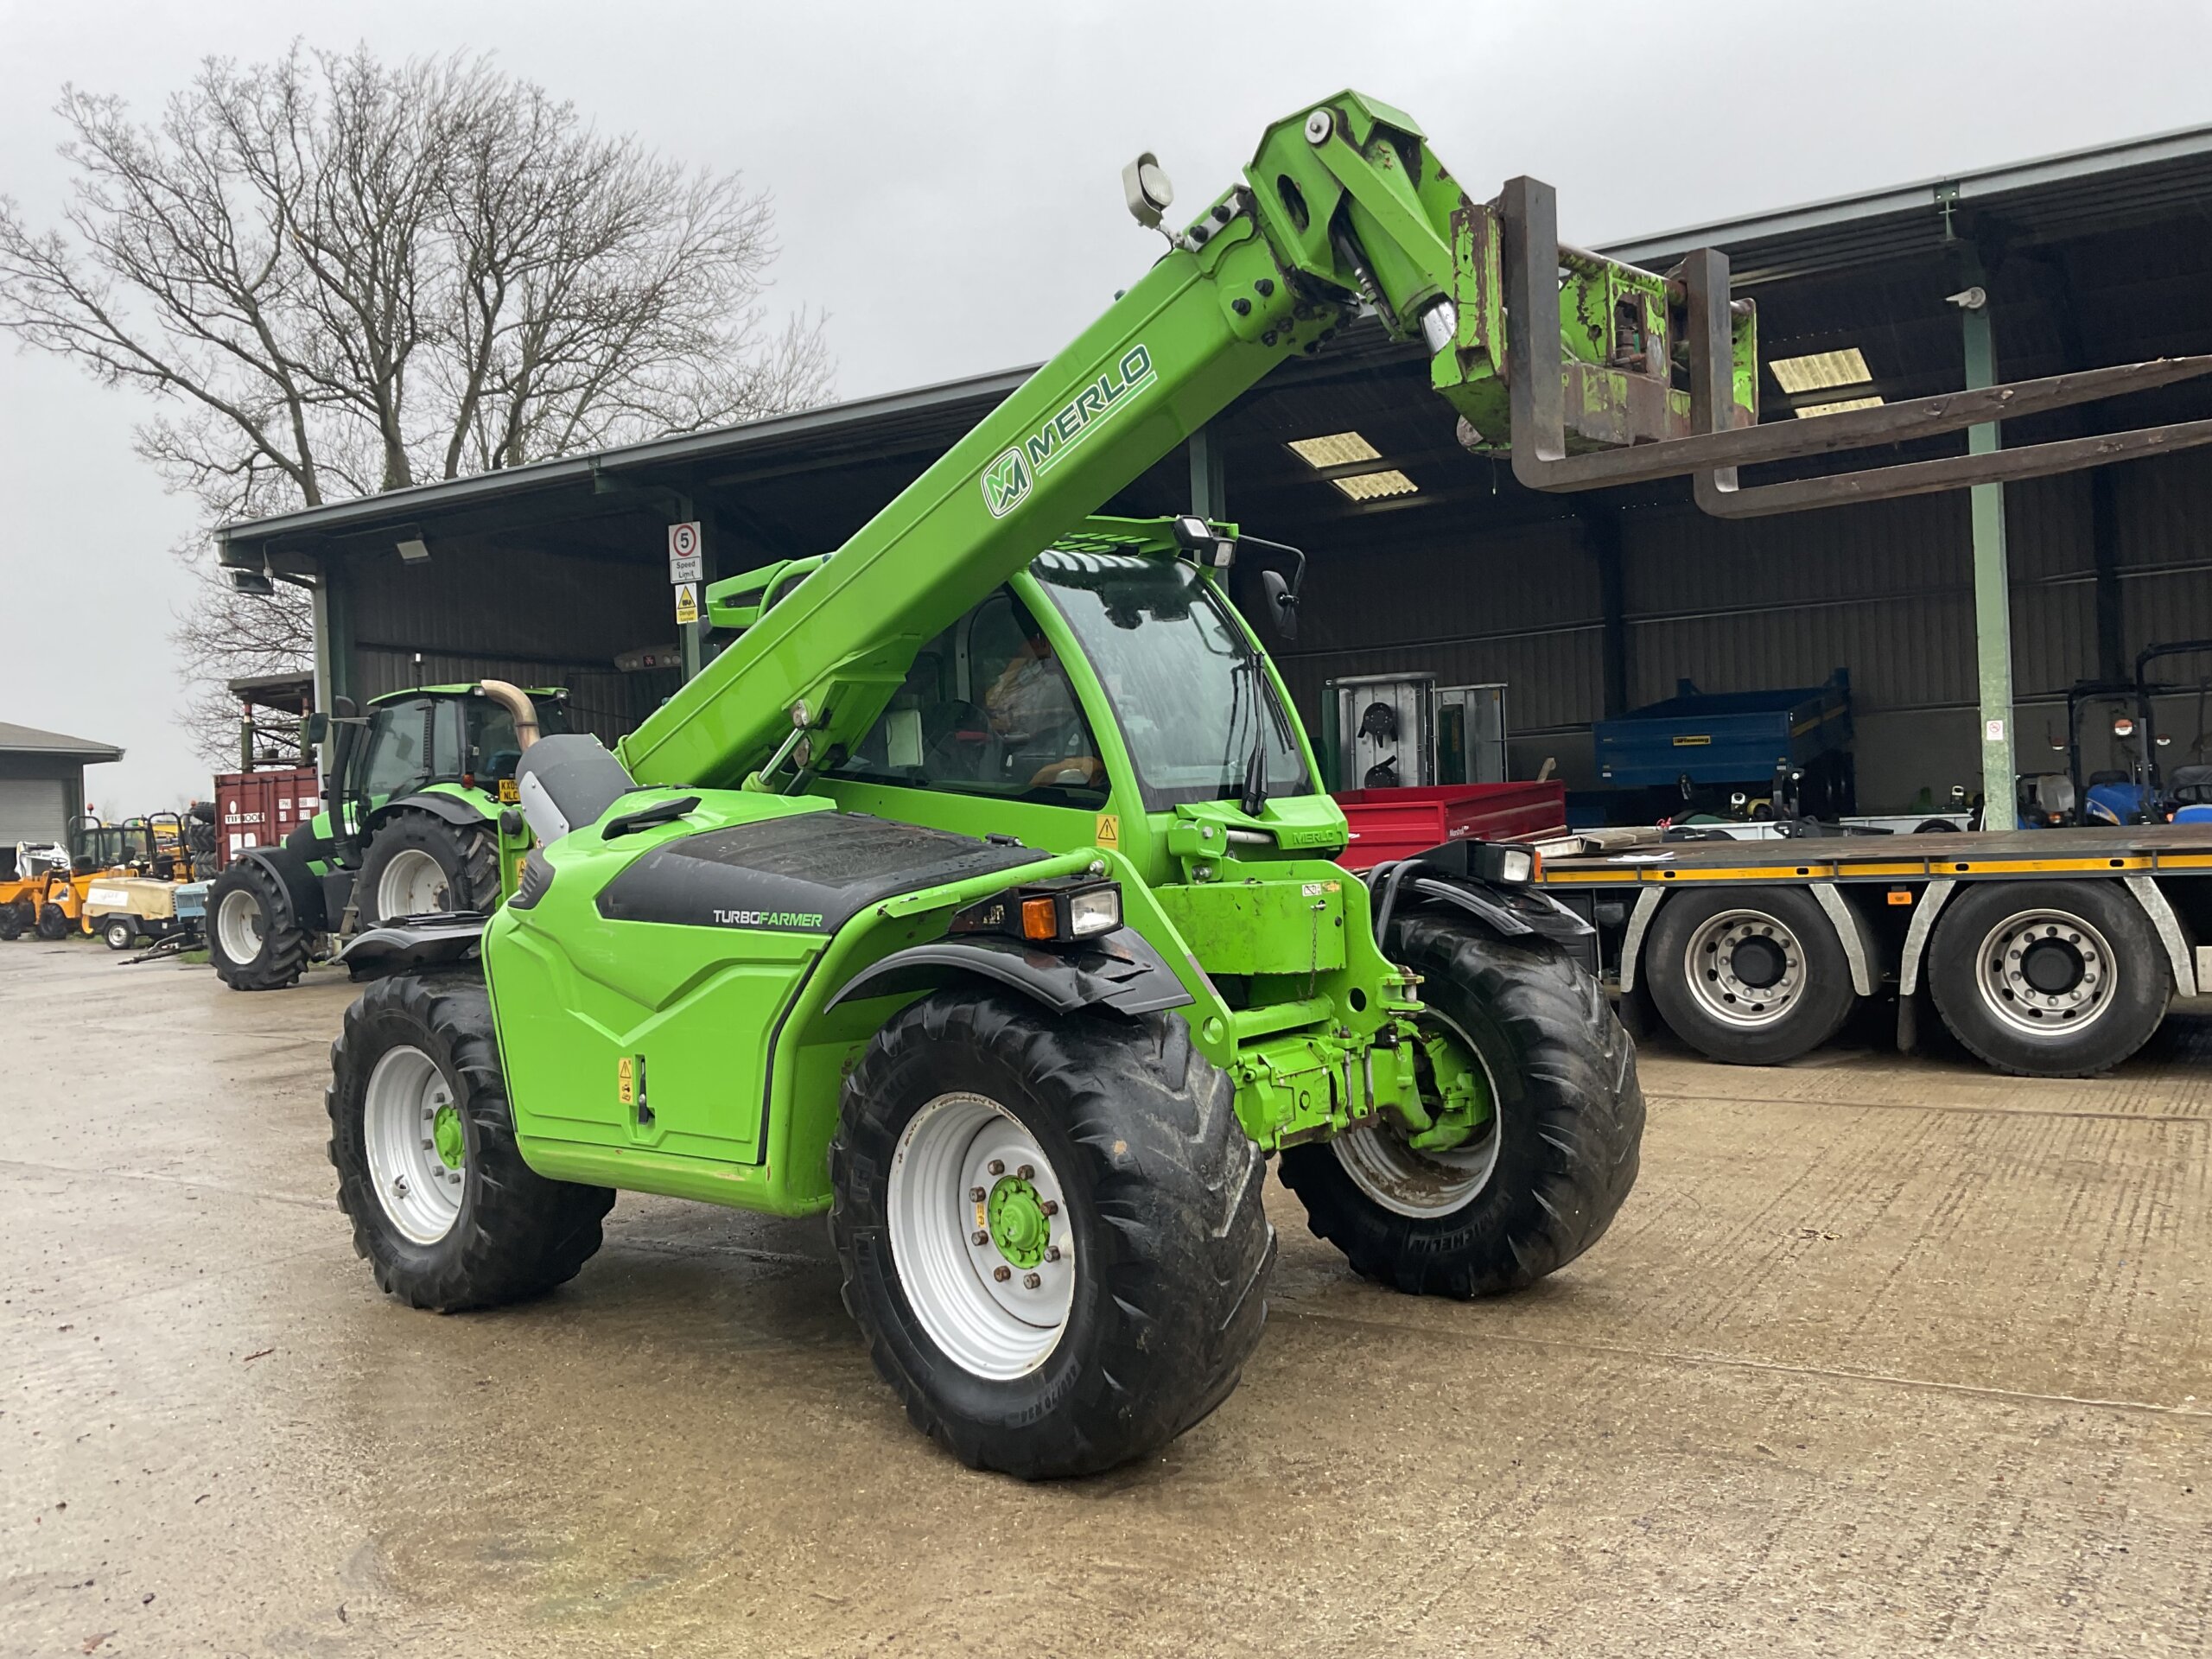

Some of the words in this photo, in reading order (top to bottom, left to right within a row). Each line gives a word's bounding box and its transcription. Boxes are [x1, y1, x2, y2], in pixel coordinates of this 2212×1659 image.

[1026, 344, 1151, 466] MERLO
[680, 532, 690, 549] 5
[676, 560, 696, 569] Speed
[678, 570, 694, 579] Limit
[1293, 830, 1334, 844] MERLO
[713, 909, 823, 927] TURBOFARMER
